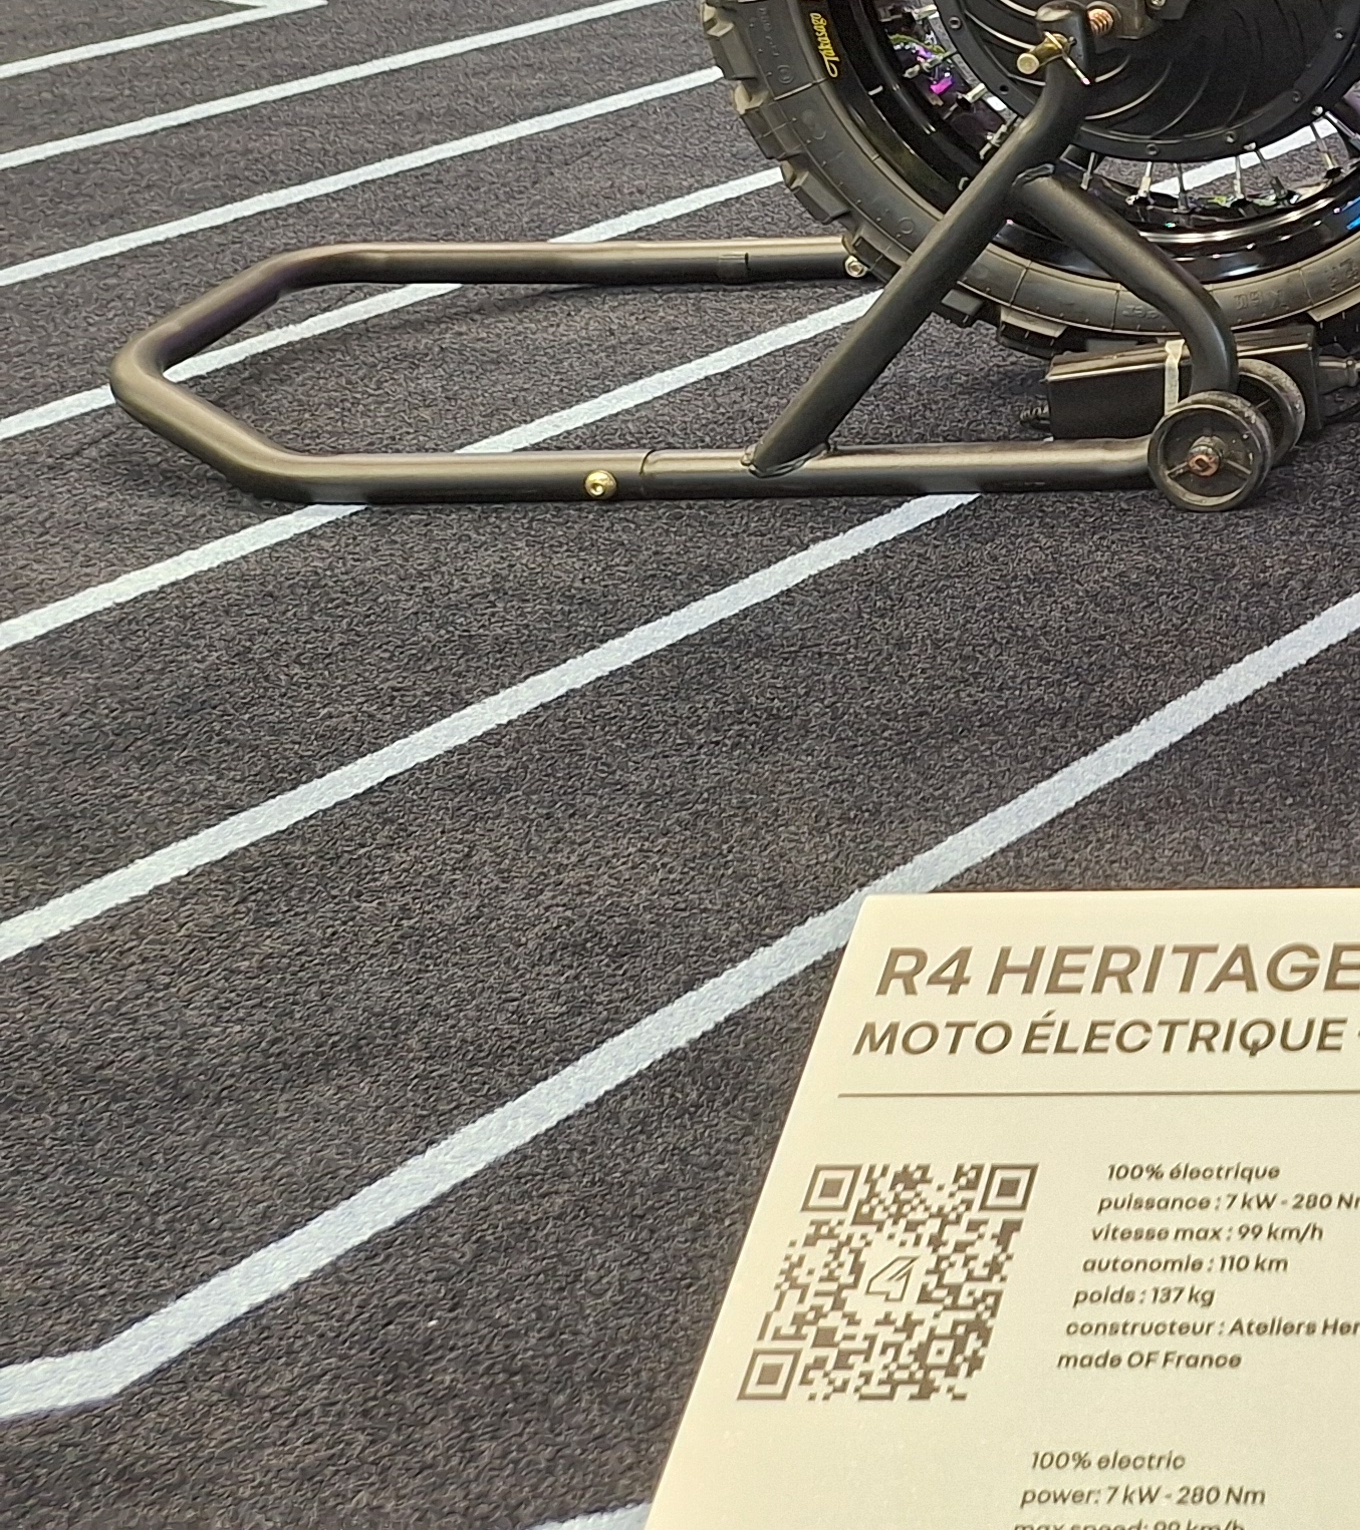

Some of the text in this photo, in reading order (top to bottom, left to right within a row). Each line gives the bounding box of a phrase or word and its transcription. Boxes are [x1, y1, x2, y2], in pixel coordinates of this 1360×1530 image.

[875, 946, 973, 997] R4
[851, 1020, 1013, 1056] MOTO
[1021, 1009, 1349, 1059] ÉLECTRIQUE
[1107, 1161, 1281, 1186] 100% électrique
[1096, 1192, 1212, 1217] puissance
[1225, 1192, 1239, 1211] 7
[1239, 1191, 1279, 1212] kW
[1291, 1192, 1334, 1212] 280
[1091, 1222, 1170, 1243] vitesse
[1172, 1226, 1224, 1243] max
[1237, 1223, 1264, 1242] 99
[1266, 1221, 1324, 1246] km/h
[1081, 1253, 1204, 1274] autonomie
[1219, 1254, 1251, 1274] 110
[1253, 1252, 1289, 1274] km
[1071, 1284, 1136, 1310] poids
[1151, 1286, 1186, 1305] 137
[1186, 1284, 1216, 1310] kg
[1065, 1319, 1216, 1337] constructeur
[1226, 1315, 1318, 1338] Ateliers
[1055, 1348, 1243, 1371] made OF France
[1031, 1448, 1187, 1472] 100% electric
[1019, 1488, 1102, 1510] power:
[1106, 1485, 1120, 1505] 7
[1121, 1483, 1163, 1506] kW
[1175, 1484, 1221, 1506] 280
[1224, 1484, 1266, 1507] Nm
